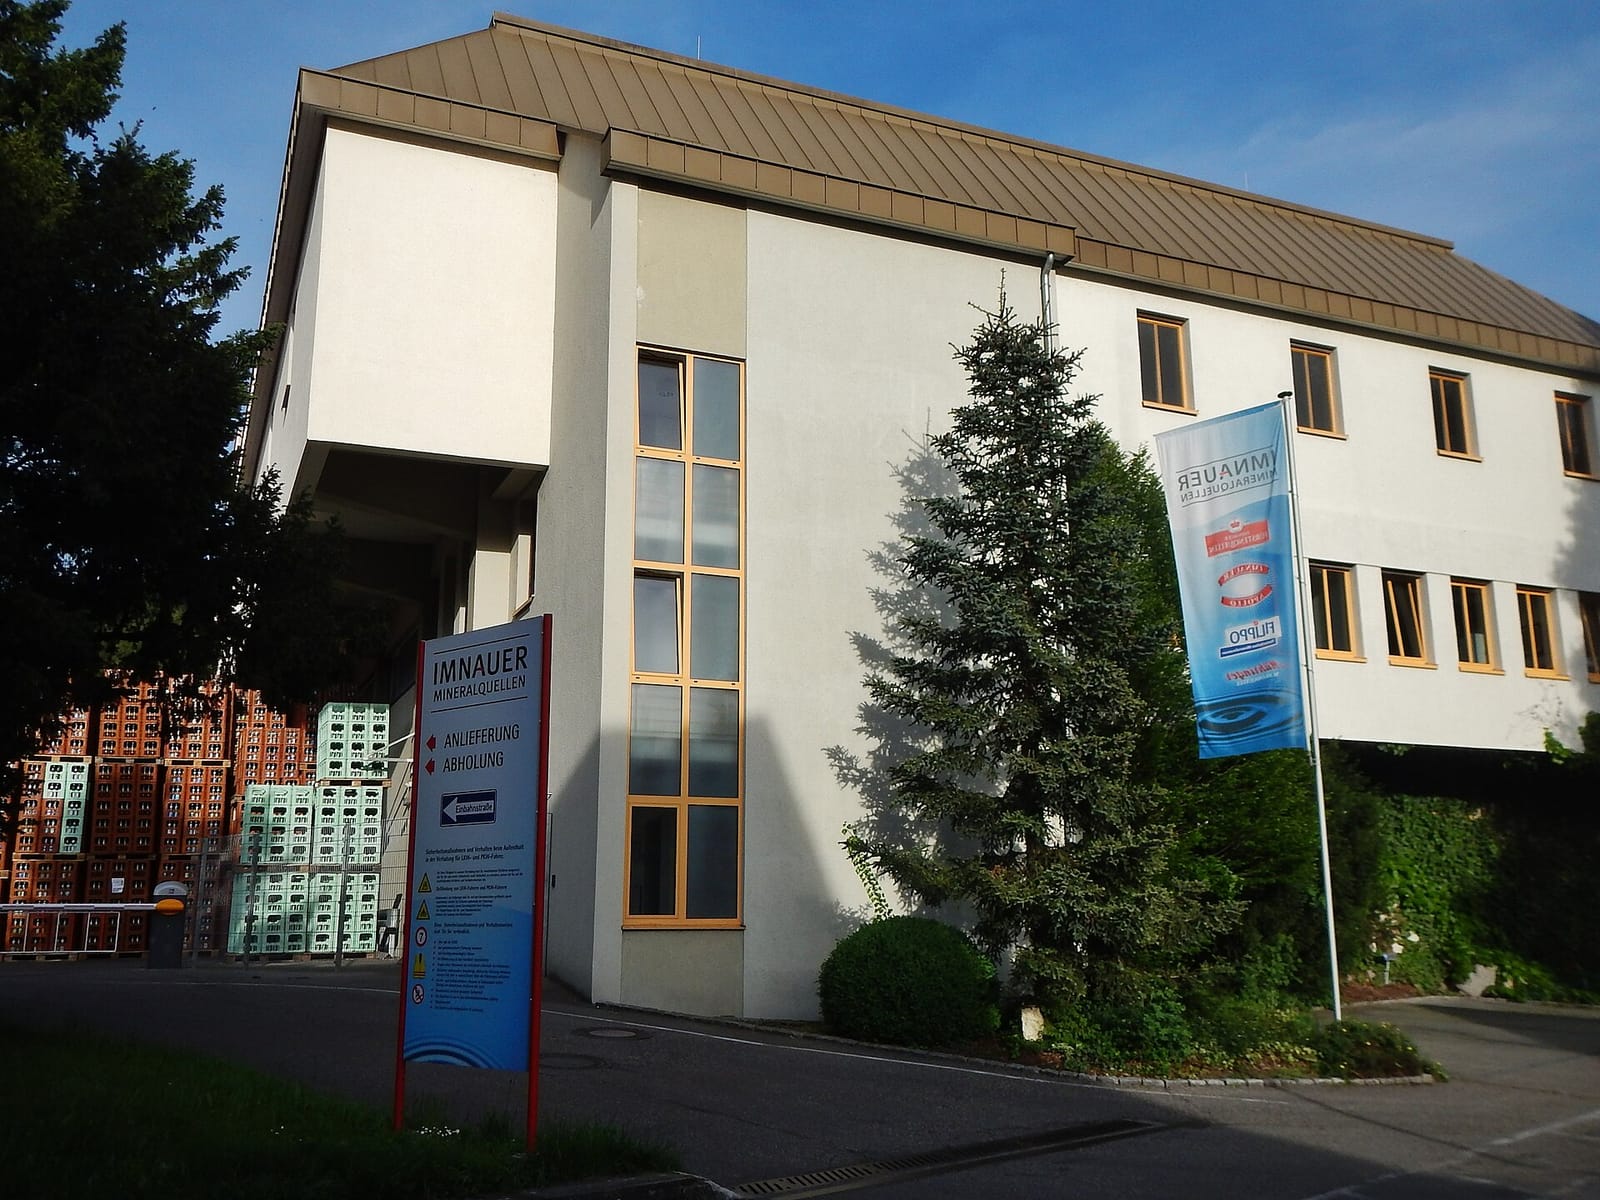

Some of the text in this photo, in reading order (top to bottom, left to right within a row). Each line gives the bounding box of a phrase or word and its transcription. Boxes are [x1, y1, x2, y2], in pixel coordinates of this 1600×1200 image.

[433, 646, 528, 685] IMNAUER
[433, 675, 526, 702] MINERALQUELLEN
[444, 724, 520, 749] ANLIEFERUNG
[443, 751, 504, 773] ABHOLUNG
